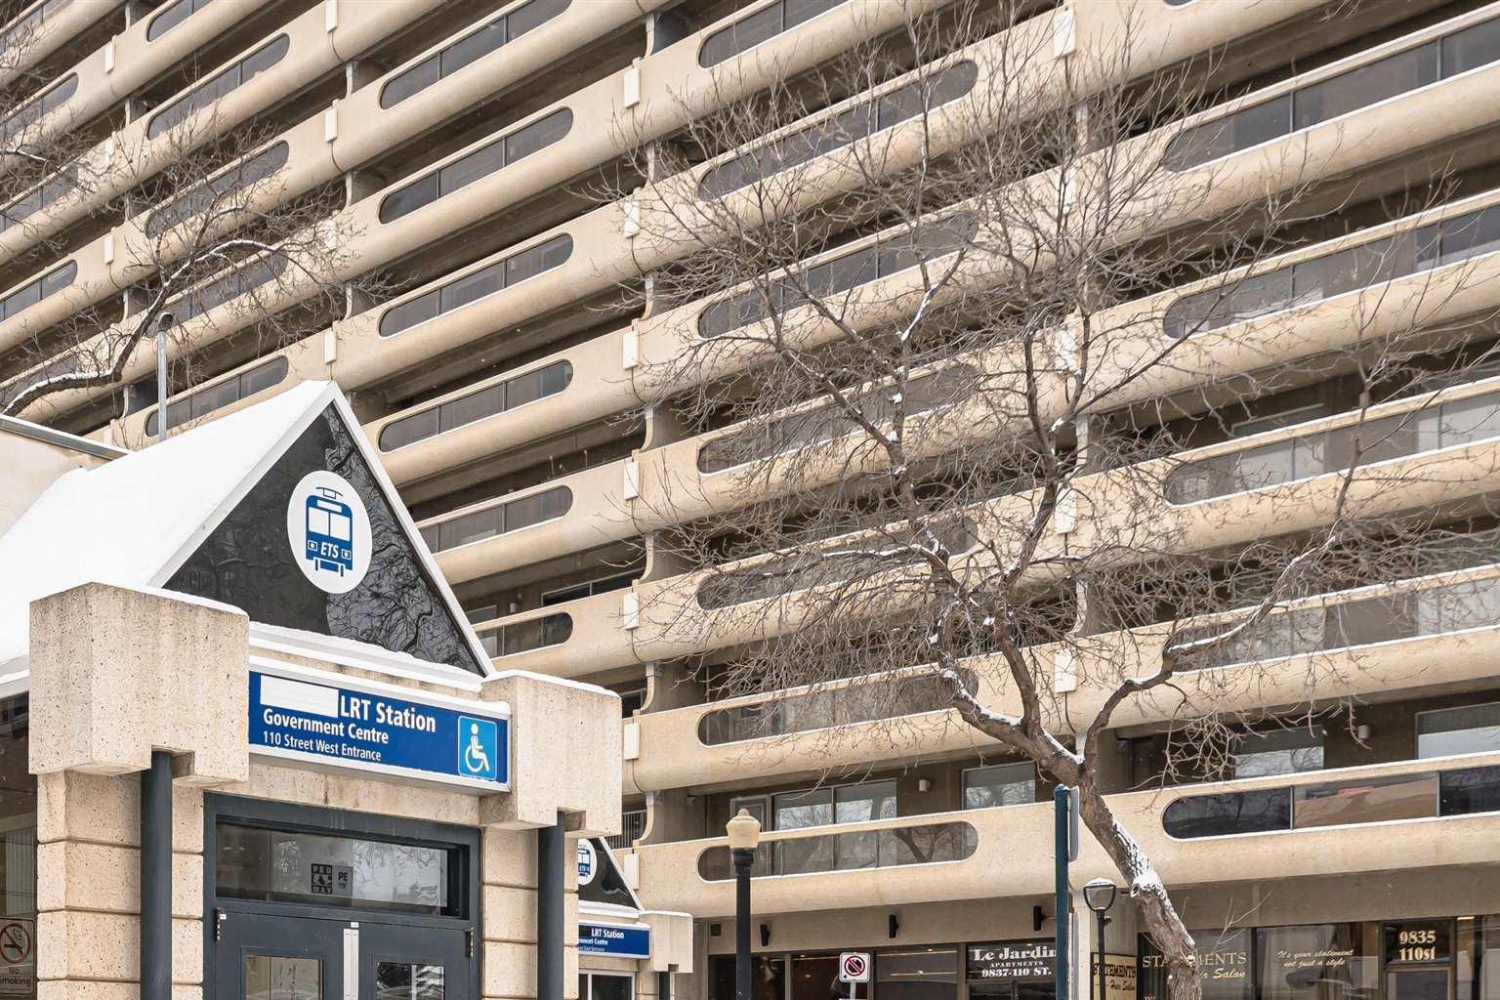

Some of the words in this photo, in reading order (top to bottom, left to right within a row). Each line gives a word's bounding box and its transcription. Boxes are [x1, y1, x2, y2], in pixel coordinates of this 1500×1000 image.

[321, 542, 339, 559] ETS
[340, 695, 370, 721] LRT
[375, 702, 437, 733] Station
[264, 709, 345, 737] Government
[348, 722, 389, 745] Centre
[263, 731, 282, 746] 110
[284, 734, 314, 751] Street
[315, 739, 339, 756] West
[341, 745, 382, 762] Entrance
[591, 928, 602, 937] LRT
[603, 929, 625, 939] Station
[1399, 930, 1436, 945] 9835
[974, 949, 995, 961] Le
[1399, 946, 1435, 961] 110st
[8, 967, 20, 975] No
[982, 969, 1030, 978] 9837-110
[1033, 966, 1052, 977] ST.
[1213, 967, 1246, 979] Salon
